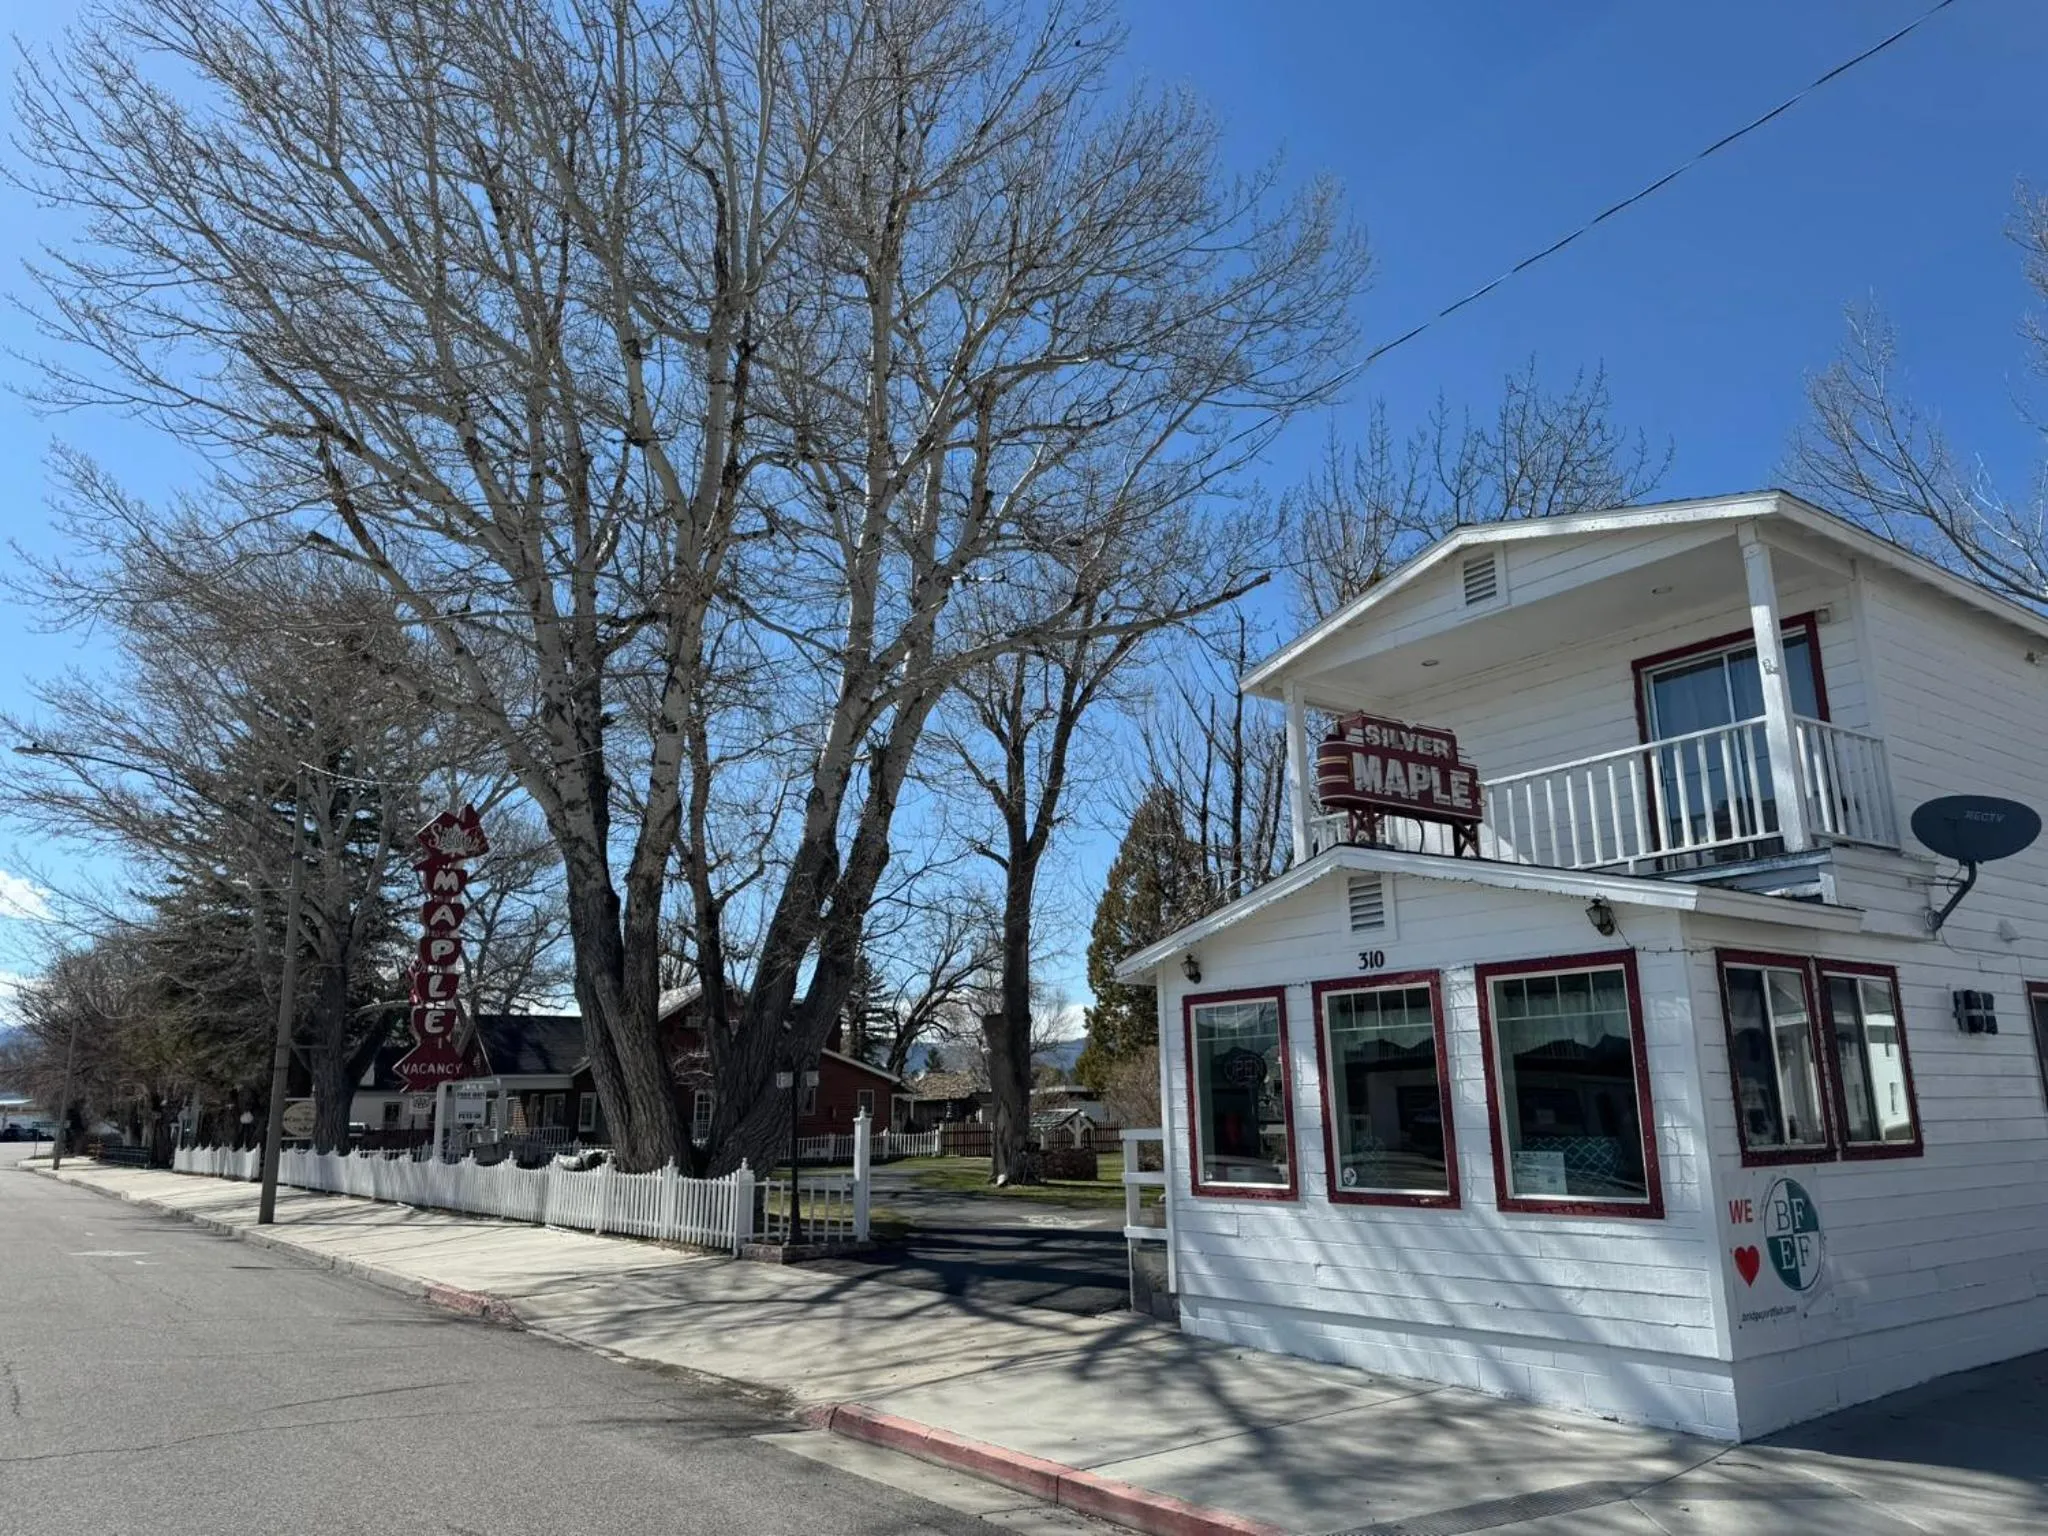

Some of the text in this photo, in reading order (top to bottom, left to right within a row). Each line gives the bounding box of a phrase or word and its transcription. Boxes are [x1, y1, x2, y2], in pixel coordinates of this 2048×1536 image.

[1363, 724, 1450, 759] SILVER
[1352, 752, 1473, 809] MAPLE
[423, 870, 460, 1034] MAPLE
[1358, 950, 1385, 970] 310
[402, 1062, 463, 1075] VACANCY
[1729, 1200, 1753, 1224] WE
